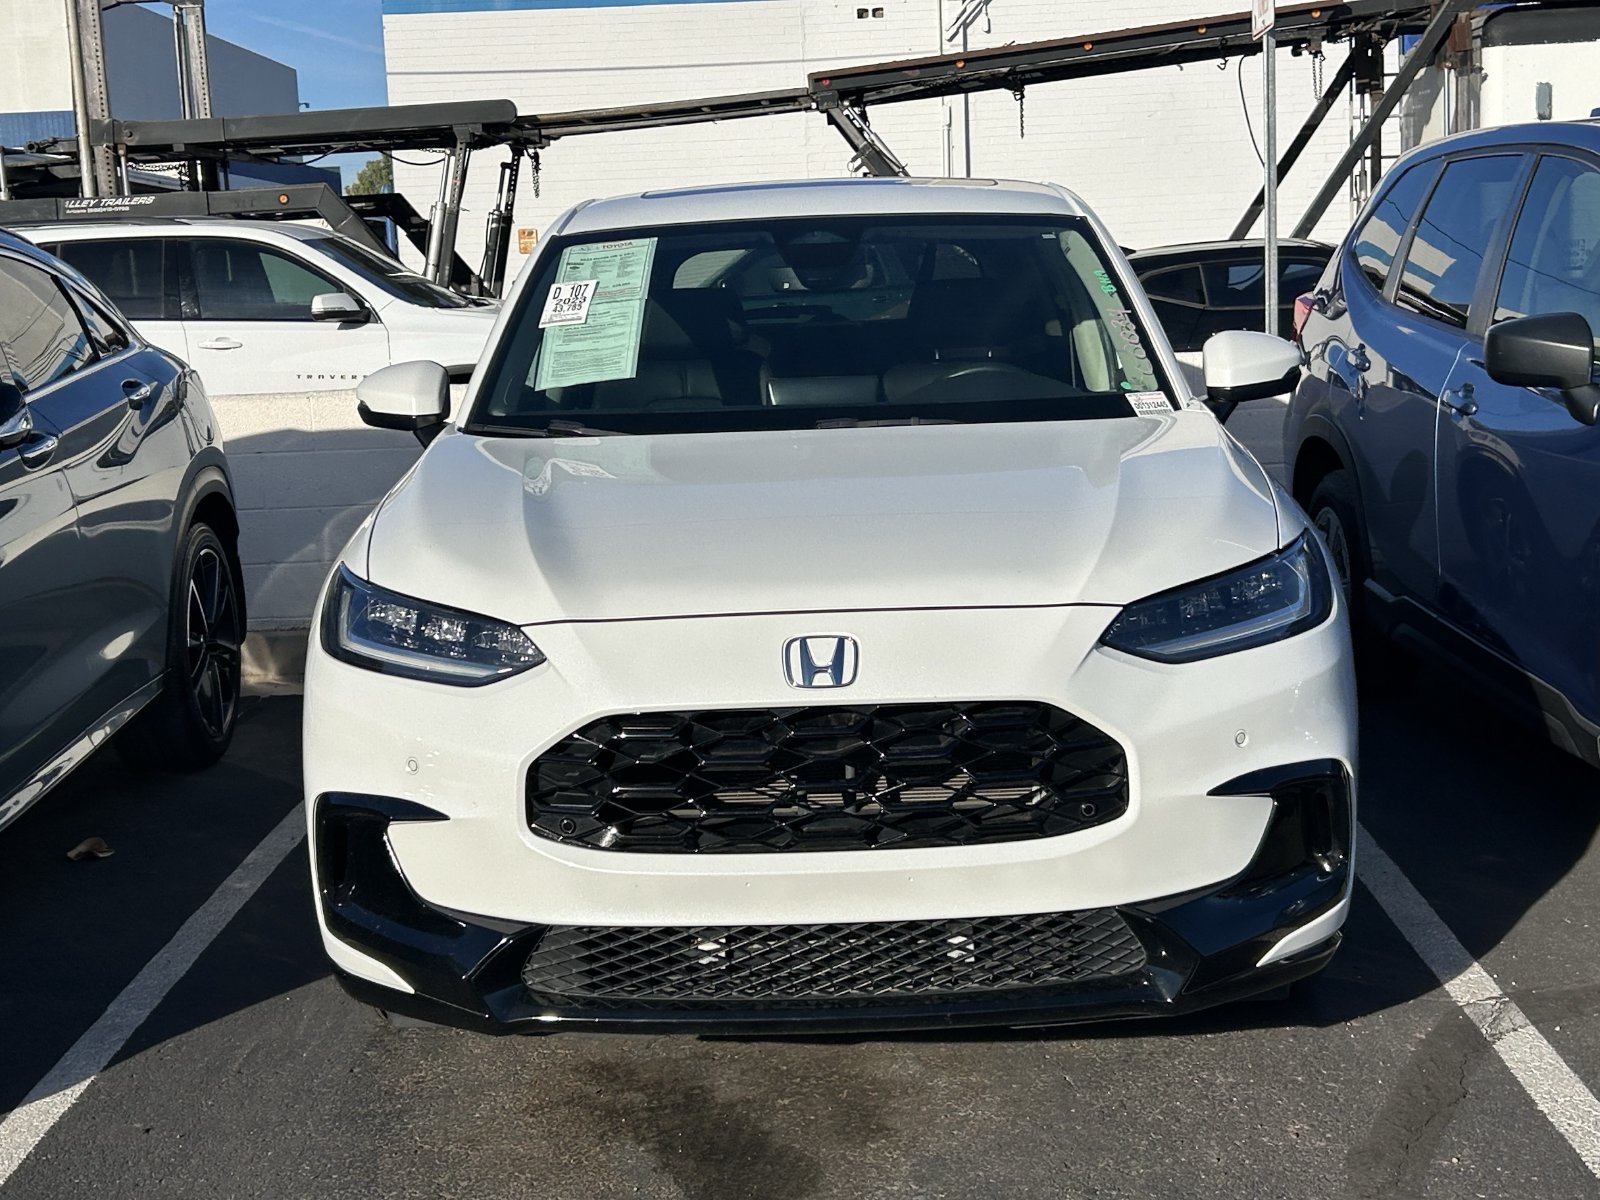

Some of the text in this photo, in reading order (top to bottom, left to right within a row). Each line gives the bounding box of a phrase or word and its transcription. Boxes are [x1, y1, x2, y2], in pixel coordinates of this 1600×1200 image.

[100, 196, 155, 206] TRAILERS
[602, 241, 633, 249] TOYOTA
[553, 287, 562, 299] D
[570, 284, 589, 298] 107
[555, 296, 587, 305] 2023
